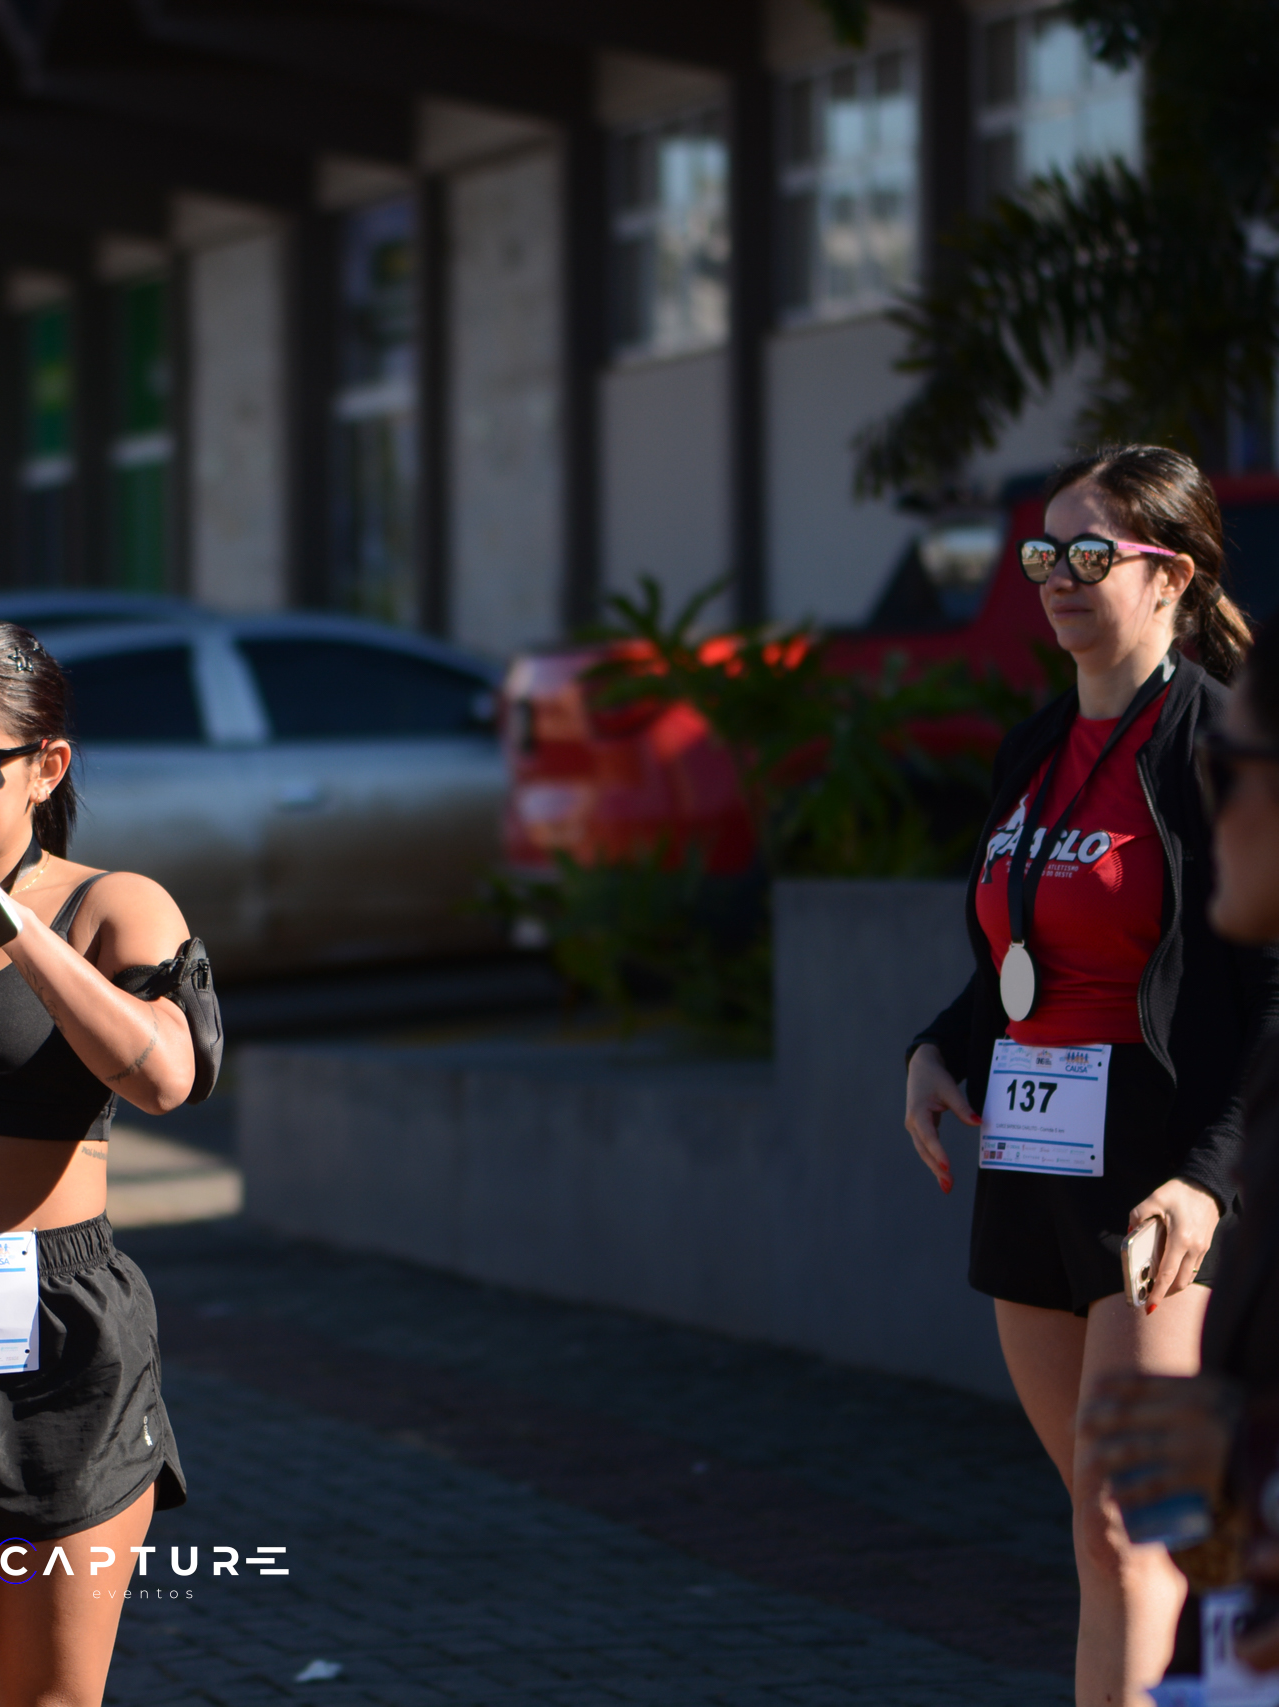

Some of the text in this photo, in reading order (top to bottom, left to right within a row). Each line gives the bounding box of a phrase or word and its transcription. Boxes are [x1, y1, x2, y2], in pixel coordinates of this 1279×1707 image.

[1047, 863, 1079, 872] ATLETISMO
[1054, 870, 1073, 878] OESTE
[1065, 1064, 1088, 1073] CAUSA
[1006, 1079, 1058, 1113] 137
